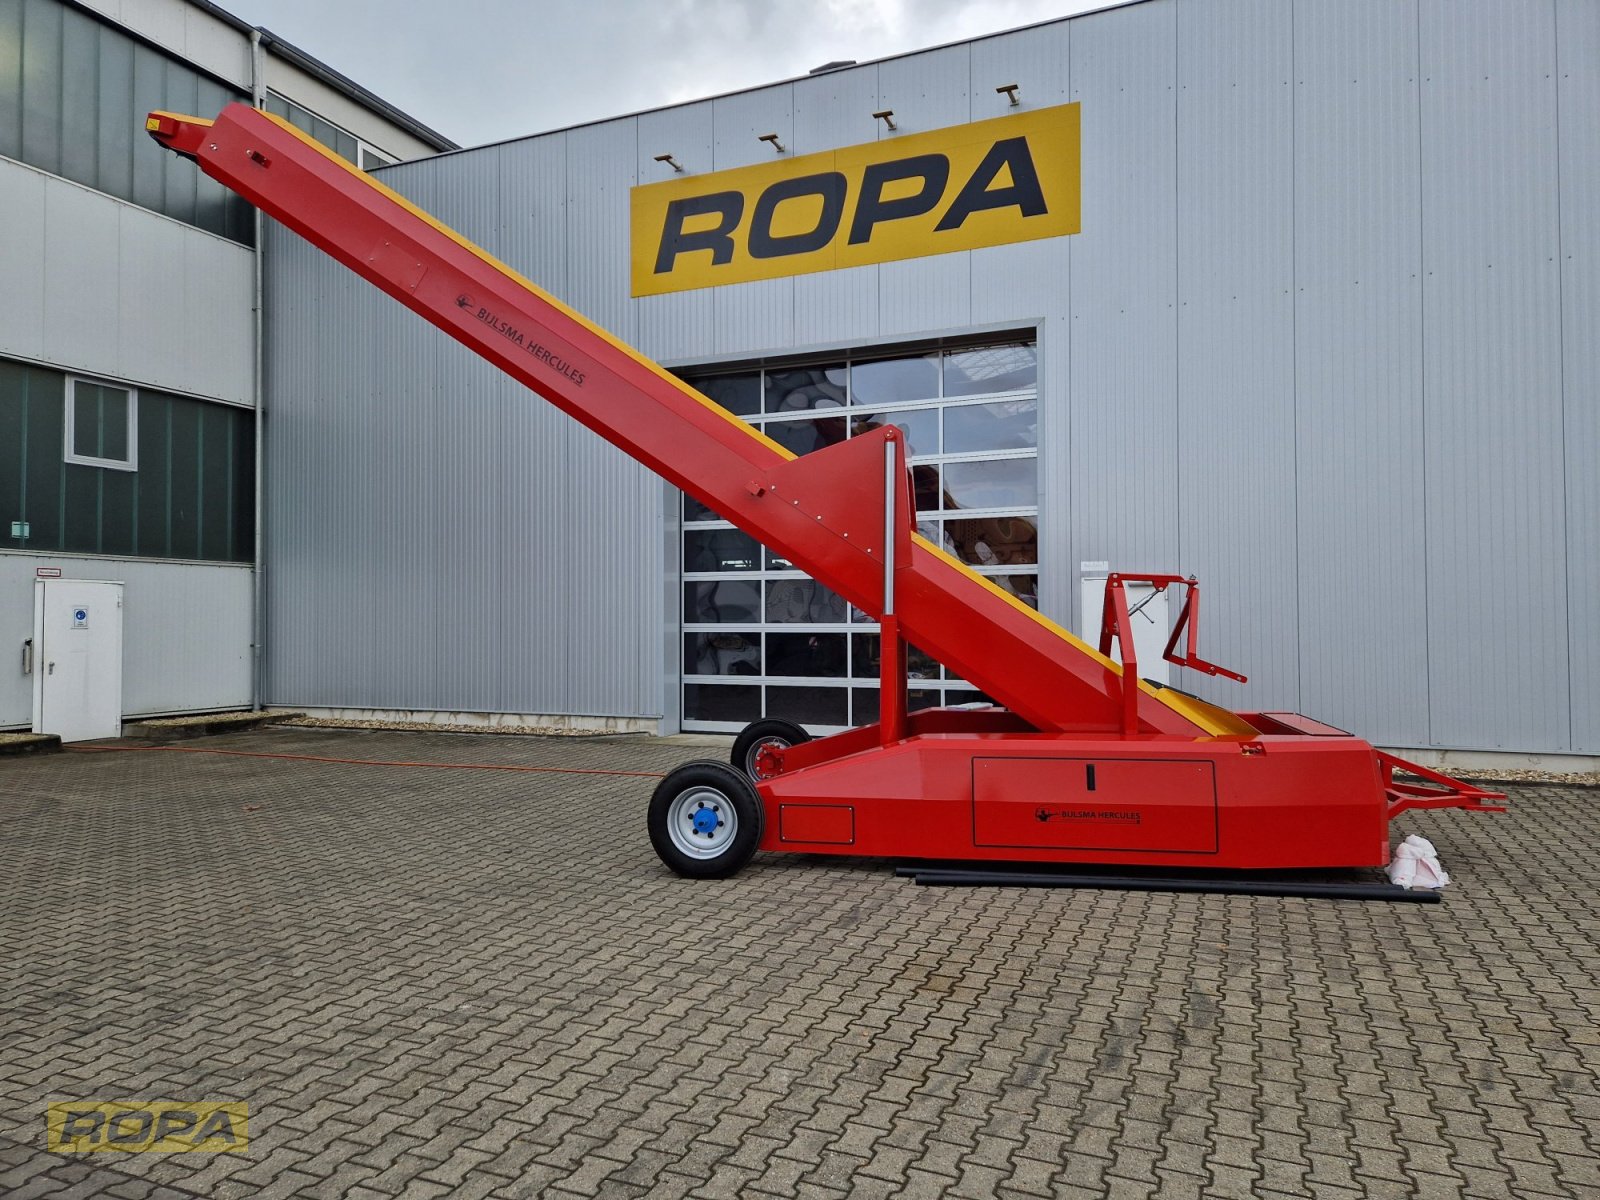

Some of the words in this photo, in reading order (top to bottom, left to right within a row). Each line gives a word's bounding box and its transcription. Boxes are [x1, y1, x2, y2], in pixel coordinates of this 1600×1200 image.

[653, 136, 1049, 275] ROPA
[477, 308, 525, 345] BIJLSMA
[526, 340, 587, 385] HERCULES
[1098, 811, 1141, 820] HERCULES
